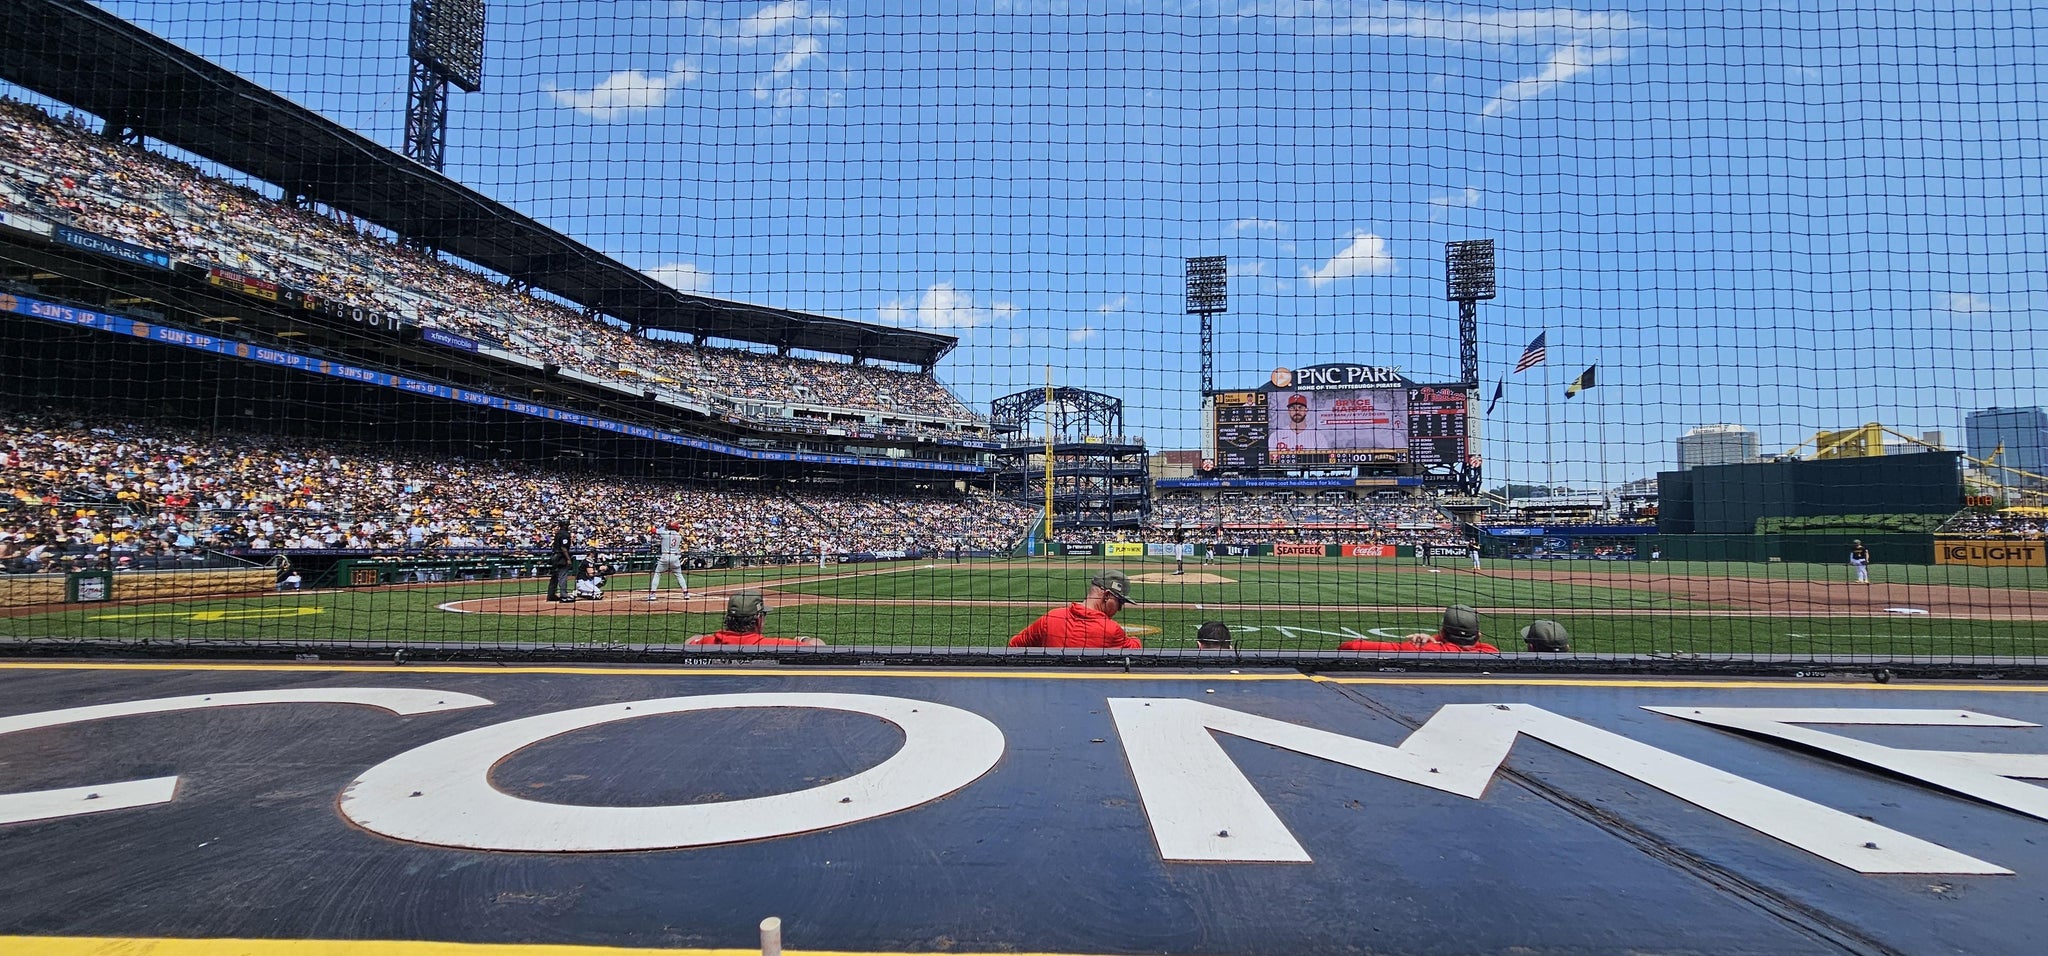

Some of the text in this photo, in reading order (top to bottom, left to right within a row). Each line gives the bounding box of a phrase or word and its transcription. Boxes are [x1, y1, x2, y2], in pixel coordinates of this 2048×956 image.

[67, 232, 141, 260] HIGHMARK
[284, 291, 292, 300] 4
[337, 302, 344, 310] 0
[32, 303, 73, 320] SUN'S
[78, 313, 96, 324] UP
[337, 310, 343, 318] 0
[352, 309, 363, 322] 0
[369, 313, 379, 326] 0
[387, 317, 393, 330] 1
[160, 329, 211, 348] SUN'S UP
[431, 332, 472, 348] xfinity mobile
[257, 349, 299, 365] SUN'S UP
[338, 366, 374, 381] SUN'S UP
[1297, 365, 1402, 384] PNC PARK
[670, 539, 677, 548] 3
[1227, 545, 1242, 554] Lite
[1277, 545, 1323, 556] SEATGEEK
[1430, 548, 1466, 556] BETMGM
[1944, 546, 2036, 560] IC LIGHT
